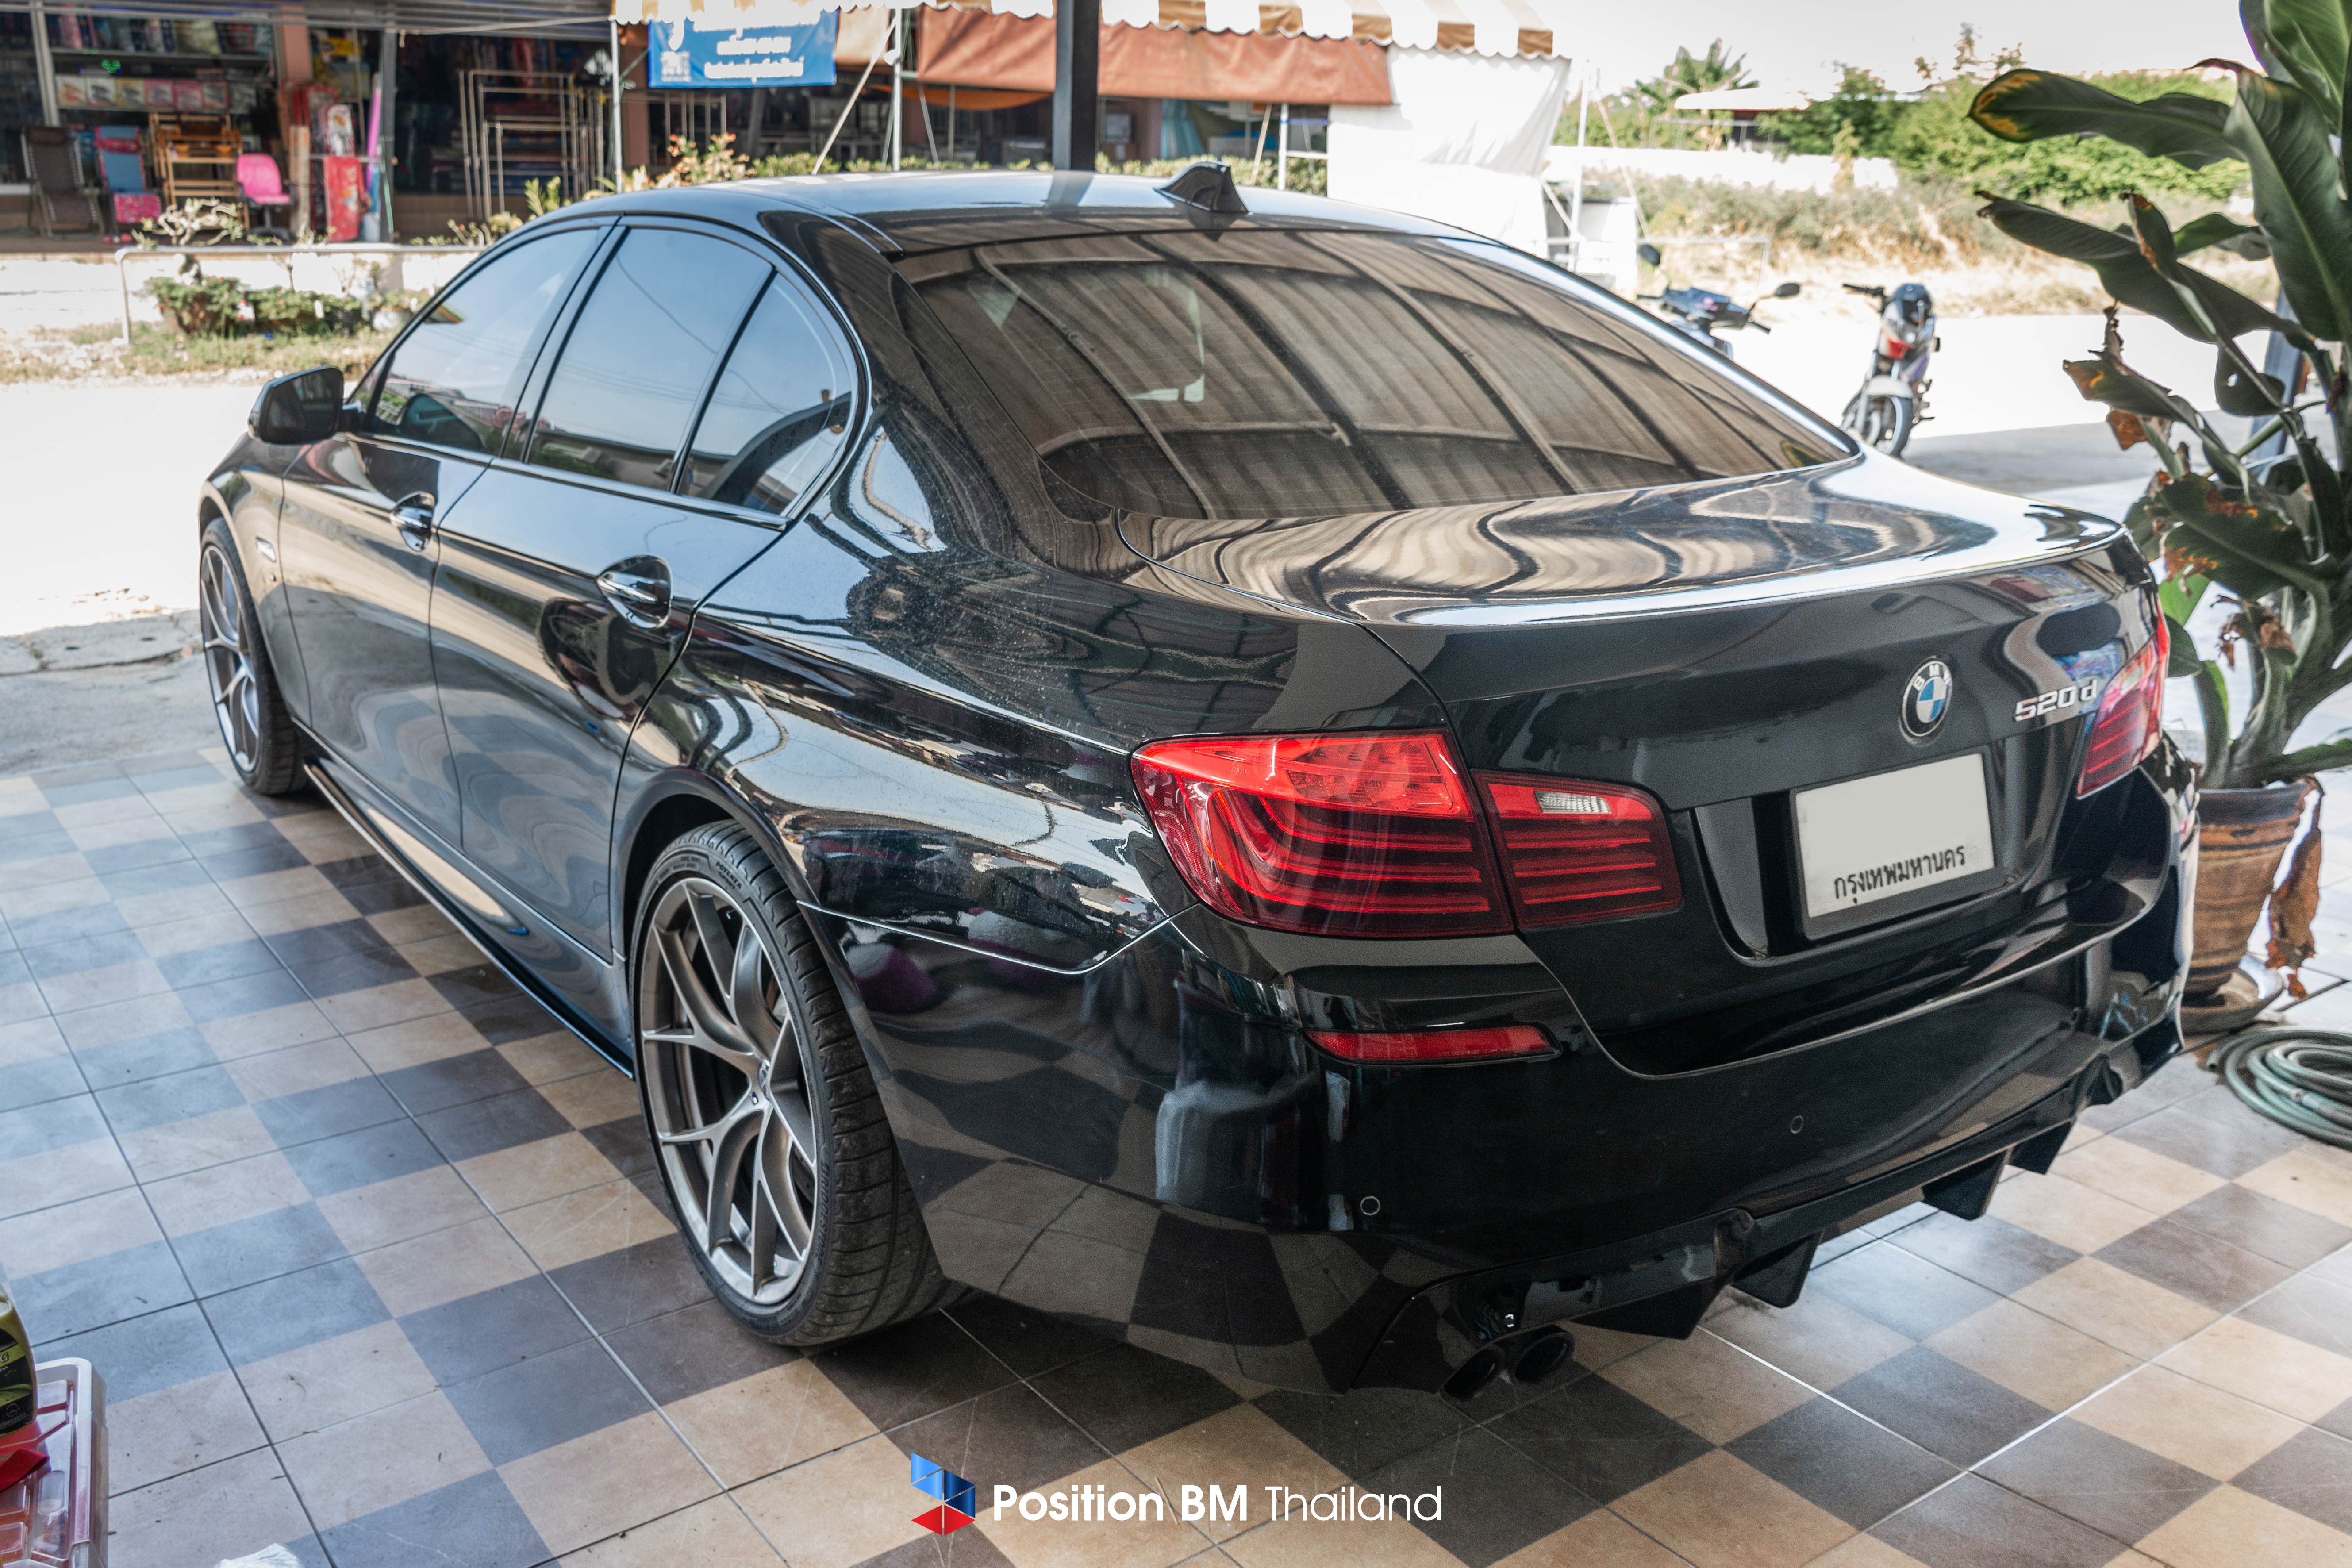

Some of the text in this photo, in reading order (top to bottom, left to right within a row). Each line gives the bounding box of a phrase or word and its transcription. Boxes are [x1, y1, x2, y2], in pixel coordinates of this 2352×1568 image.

[1913, 664, 1951, 691] BMW
[716, 861, 742, 889] POTENZA
[1834, 845, 1966, 903] กรุงเทพมหานคร
